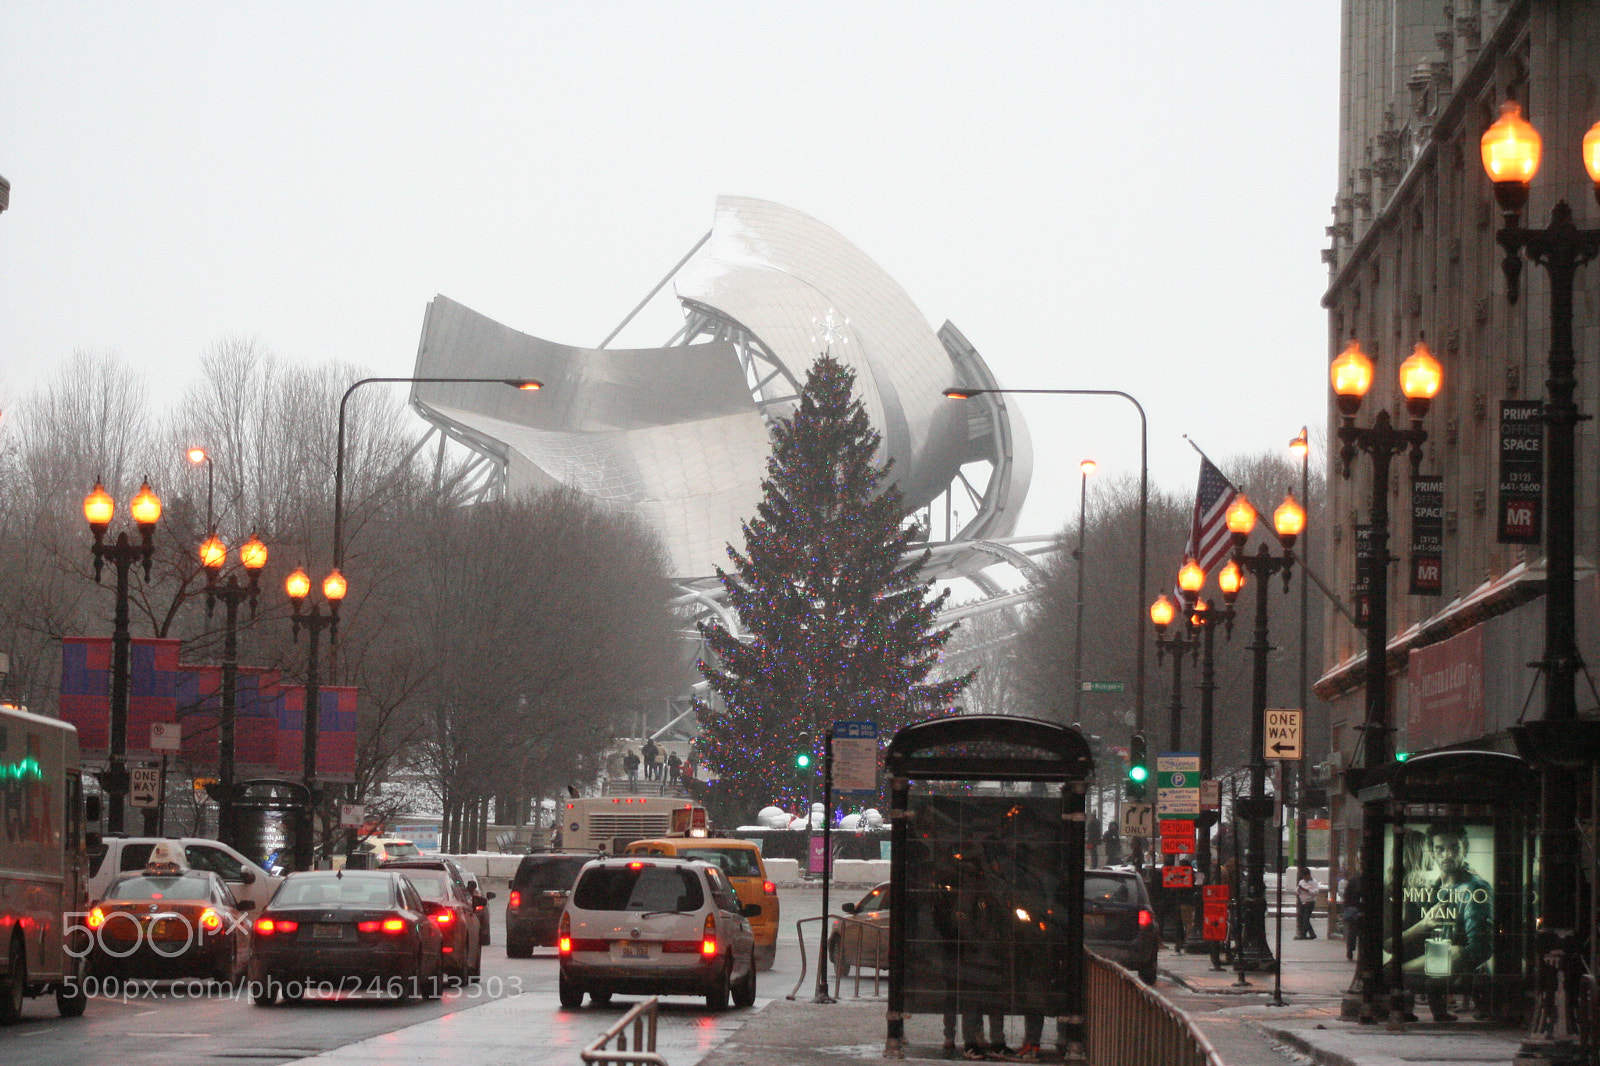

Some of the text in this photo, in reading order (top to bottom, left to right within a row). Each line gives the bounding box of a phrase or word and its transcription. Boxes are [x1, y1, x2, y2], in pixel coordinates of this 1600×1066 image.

[1502, 423, 1540, 436] OFFICE
[1503, 439, 1539, 451] SPACE
[1509, 473, 1531, 483] (312)
[1415, 482, 1443, 492] PRIME
[1501, 483, 1540, 492] 641-5600
[1413, 494, 1442, 504] OFFIC
[1506, 508, 1531, 526] MR
[1418, 566, 1438, 580] MR
[1269, 714, 1297, 725] ONE
[1269, 727, 1297, 739] WAY
[134, 771, 157, 781] ONE
[134, 782, 157, 792] WAY
[1125, 826, 1148, 835] ONLY
[1162, 822, 1192, 834] DETOUR
[1403, 888, 1488, 903] MMY CHOO
[1420, 907, 1456, 919] MAN
